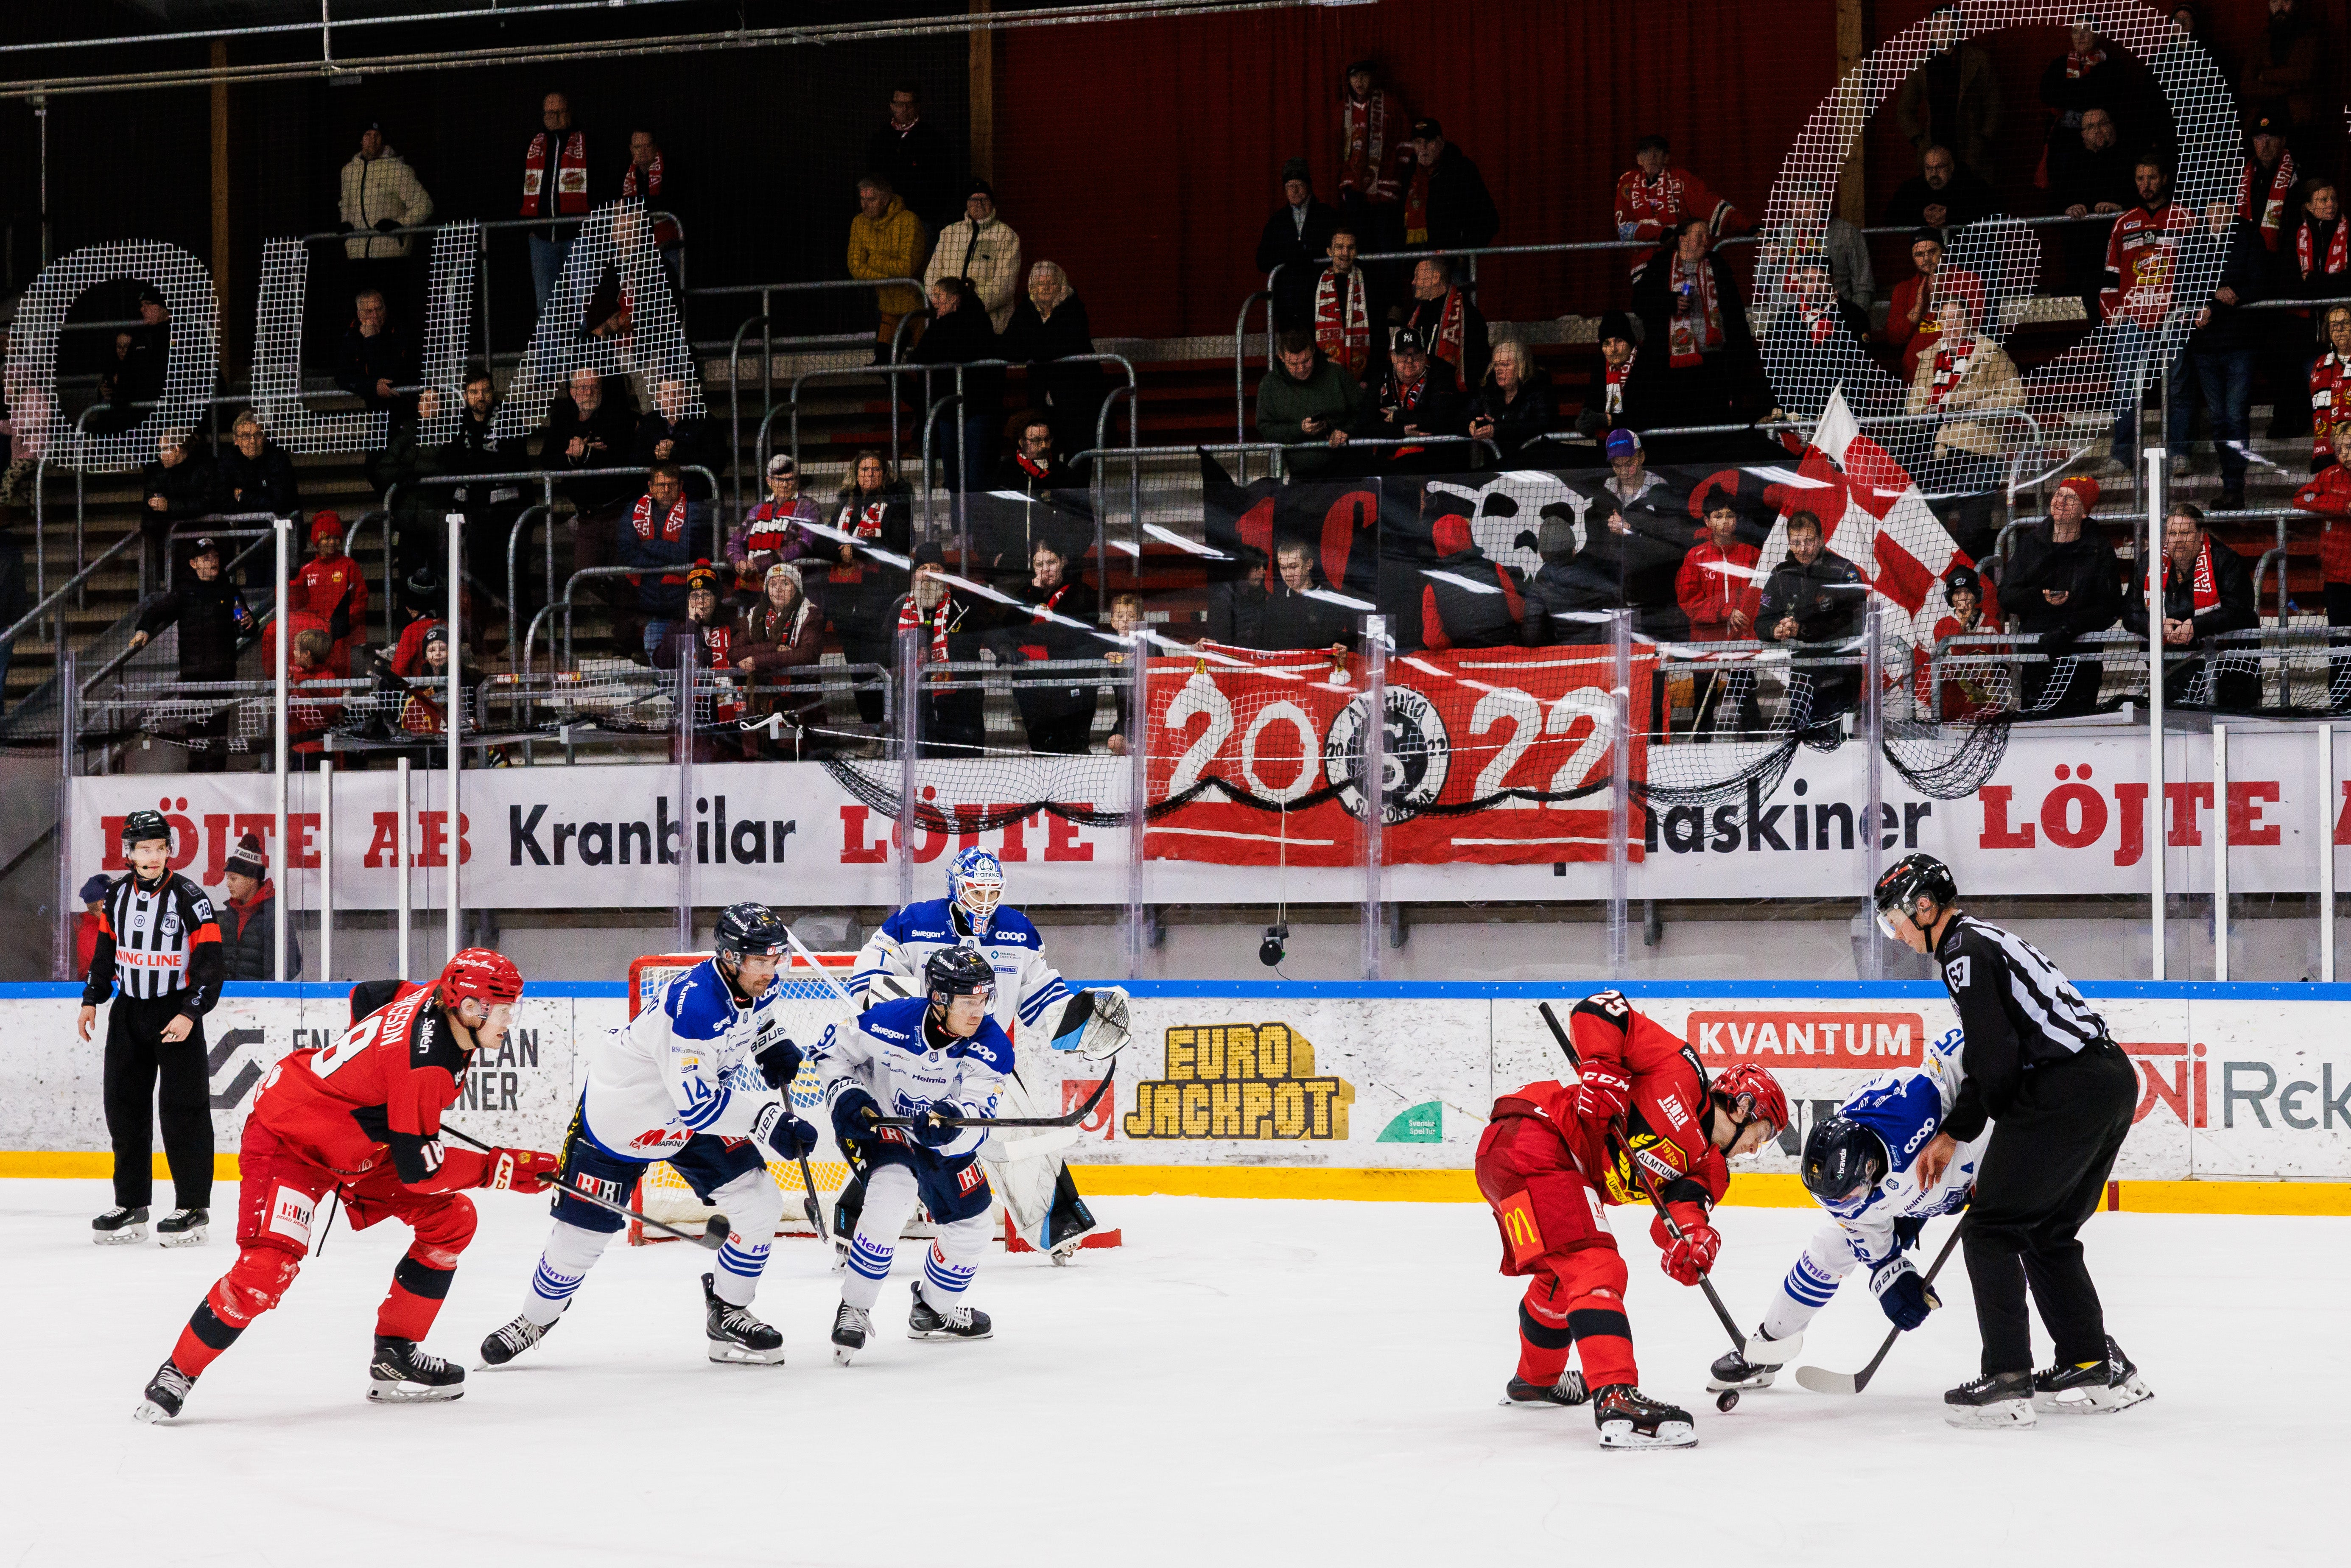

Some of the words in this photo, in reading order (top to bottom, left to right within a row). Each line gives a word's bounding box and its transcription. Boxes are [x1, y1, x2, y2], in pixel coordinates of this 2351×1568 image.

[1646, 778, 1932, 853] askiner
[1979, 763, 2281, 867] LÖJTE
[363, 811, 471, 868] AB
[509, 795, 796, 866] Kranbilar
[165, 919, 176, 929] 20
[731, 914, 749, 932] bravida
[911, 929, 941, 939] Swegon
[995, 931, 1027, 942] coop
[148, 954, 182, 967] LINE
[939, 956, 955, 971] bravida
[380, 987, 428, 1046] RIKSSON
[1590, 989, 1629, 1017] 25
[310, 1006, 387, 1079] 8
[419, 1018, 436, 1054] Sallén
[870, 1023, 900, 1040] Swegon
[1699, 1022, 1910, 1056] KVANTUM
[967, 1042, 997, 1062] coop
[1168, 1025, 1289, 1080] EURO
[911, 1073, 946, 1084] Helmia
[1683, 1048, 1704, 1086] Kinnarp
[448, 1072, 518, 1111] NER
[682, 1076, 711, 1105] 14
[1582, 1071, 1630, 1091] CCM
[1126, 1081, 1336, 1136] JACKPOT
[1666, 1112, 1681, 1132] RENTAL
[756, 1108, 778, 1145] AUER
[1409, 1127, 1425, 1136] Spel
[1904, 1117, 1935, 1154] coop
[1838, 1149, 1847, 1175] bravida
[1904, 1186, 1930, 1213] Helmia
[857, 1232, 894, 1255] Helm
[223, 1305, 244, 1320] CCM
[381, 1362, 407, 1380] CCM
